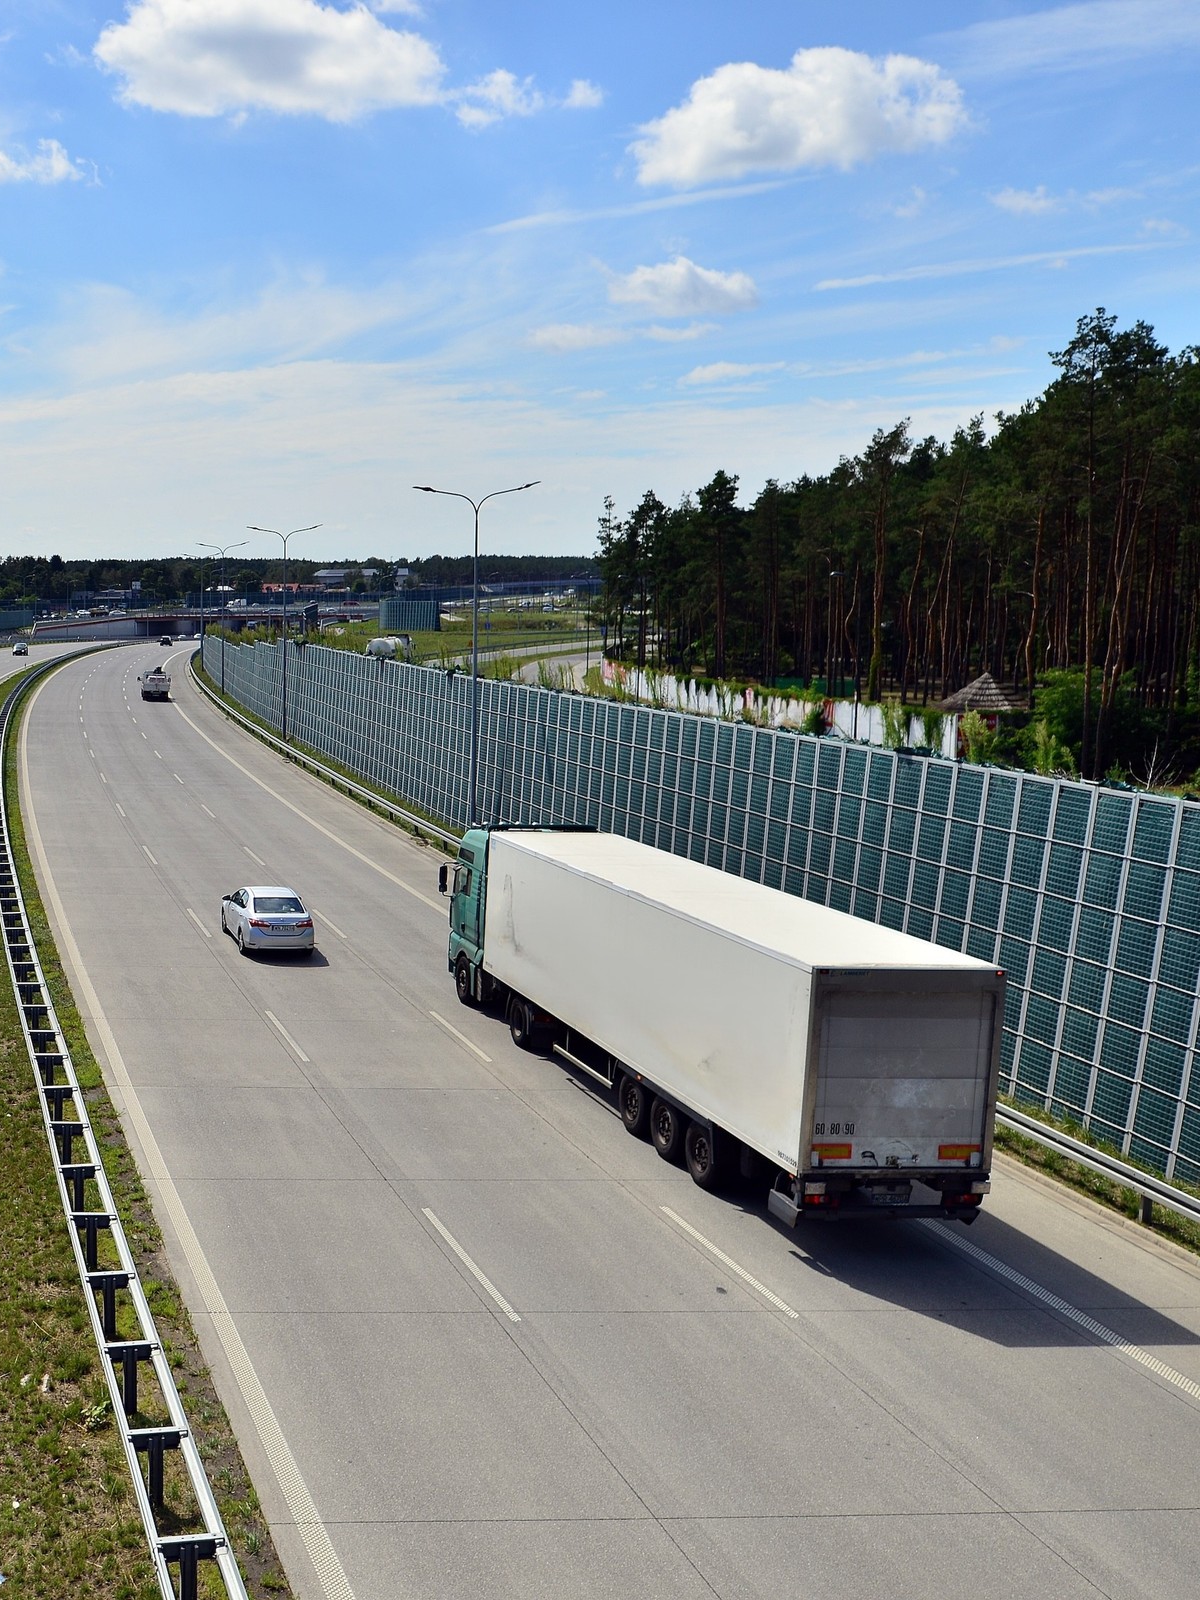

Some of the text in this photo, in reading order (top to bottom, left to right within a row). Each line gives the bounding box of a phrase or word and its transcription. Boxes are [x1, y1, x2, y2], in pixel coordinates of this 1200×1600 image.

[815, 1122, 855, 1135] 60 80 90
